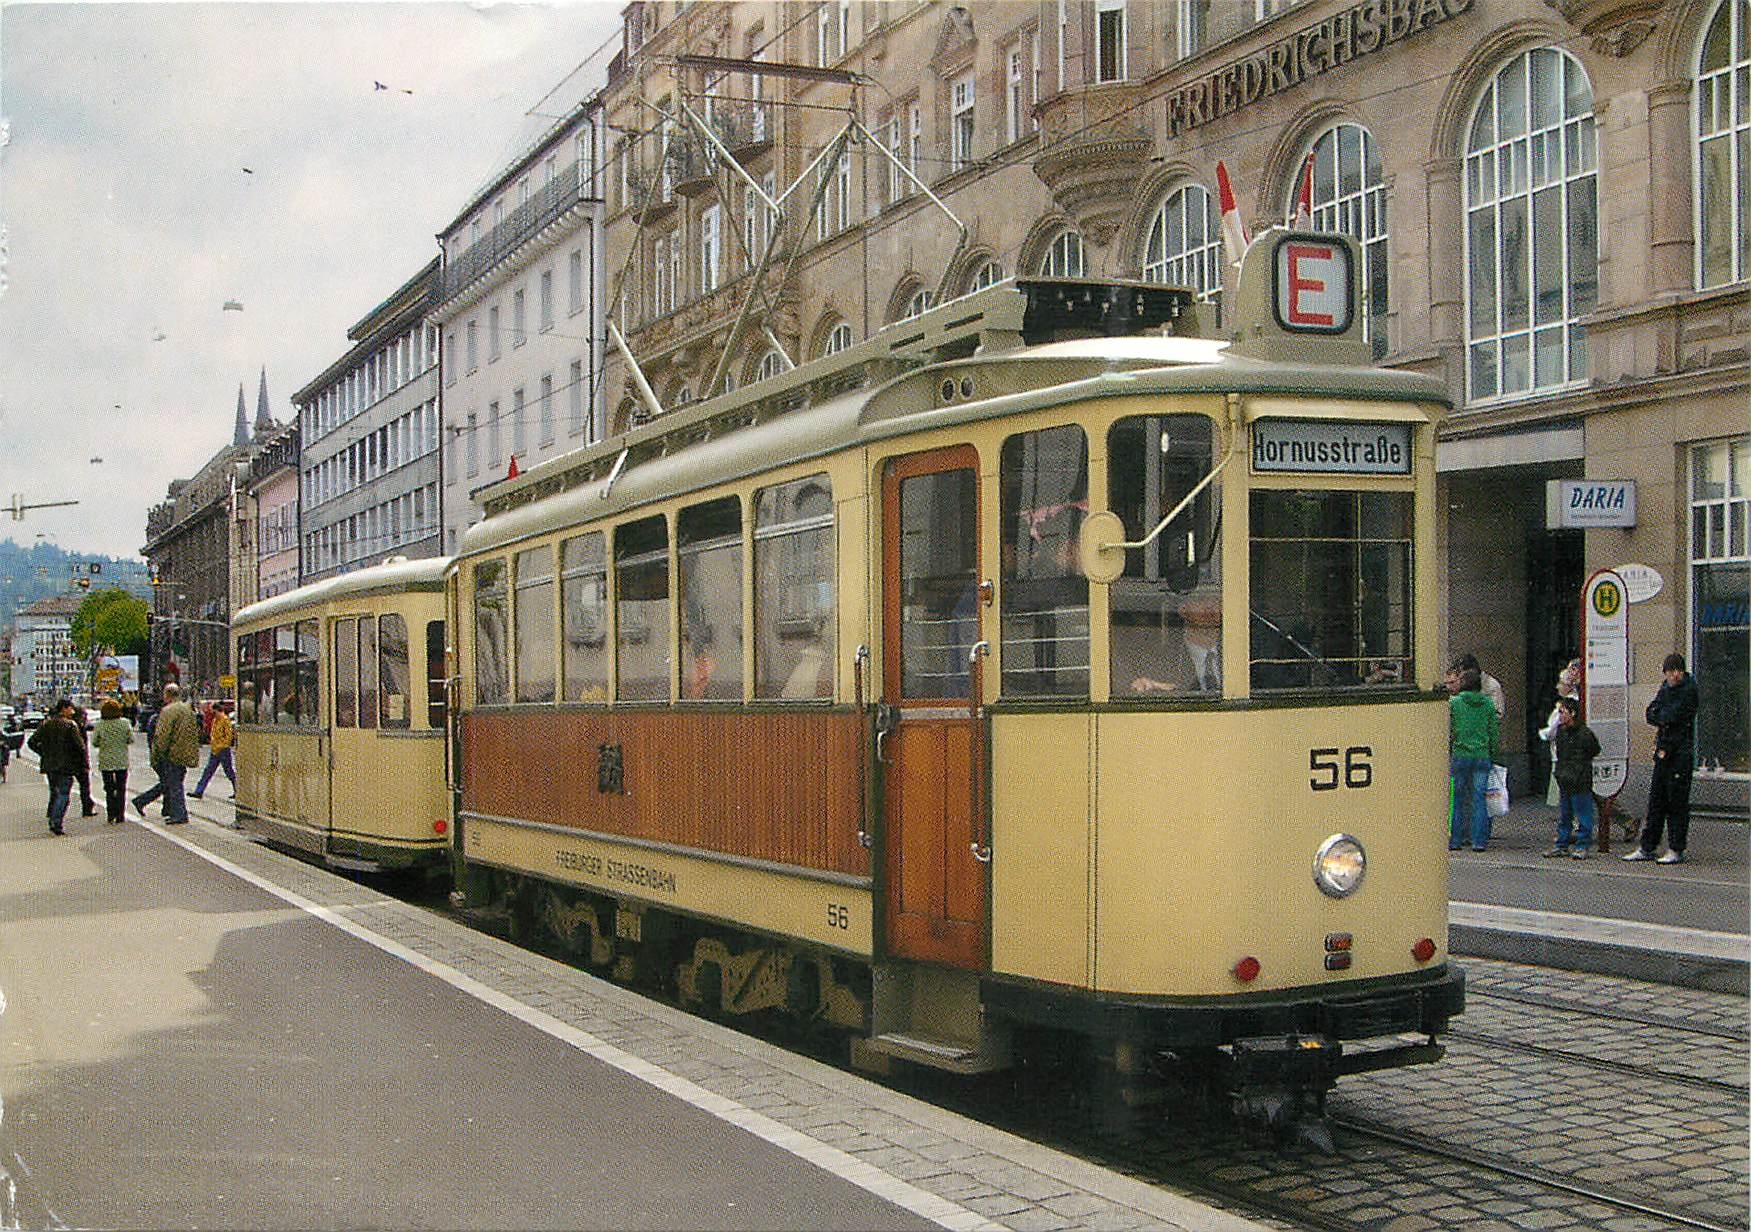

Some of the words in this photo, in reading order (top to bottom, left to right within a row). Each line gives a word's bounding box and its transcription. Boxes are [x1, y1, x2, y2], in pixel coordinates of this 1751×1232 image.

[1287, 244, 1334, 326] E
[1253, 432, 1401, 464] Hornusstraße
[1570, 486, 1625, 510] DARIA
[1310, 746, 1373, 791] 56
[828, 904, 849, 930] 56
